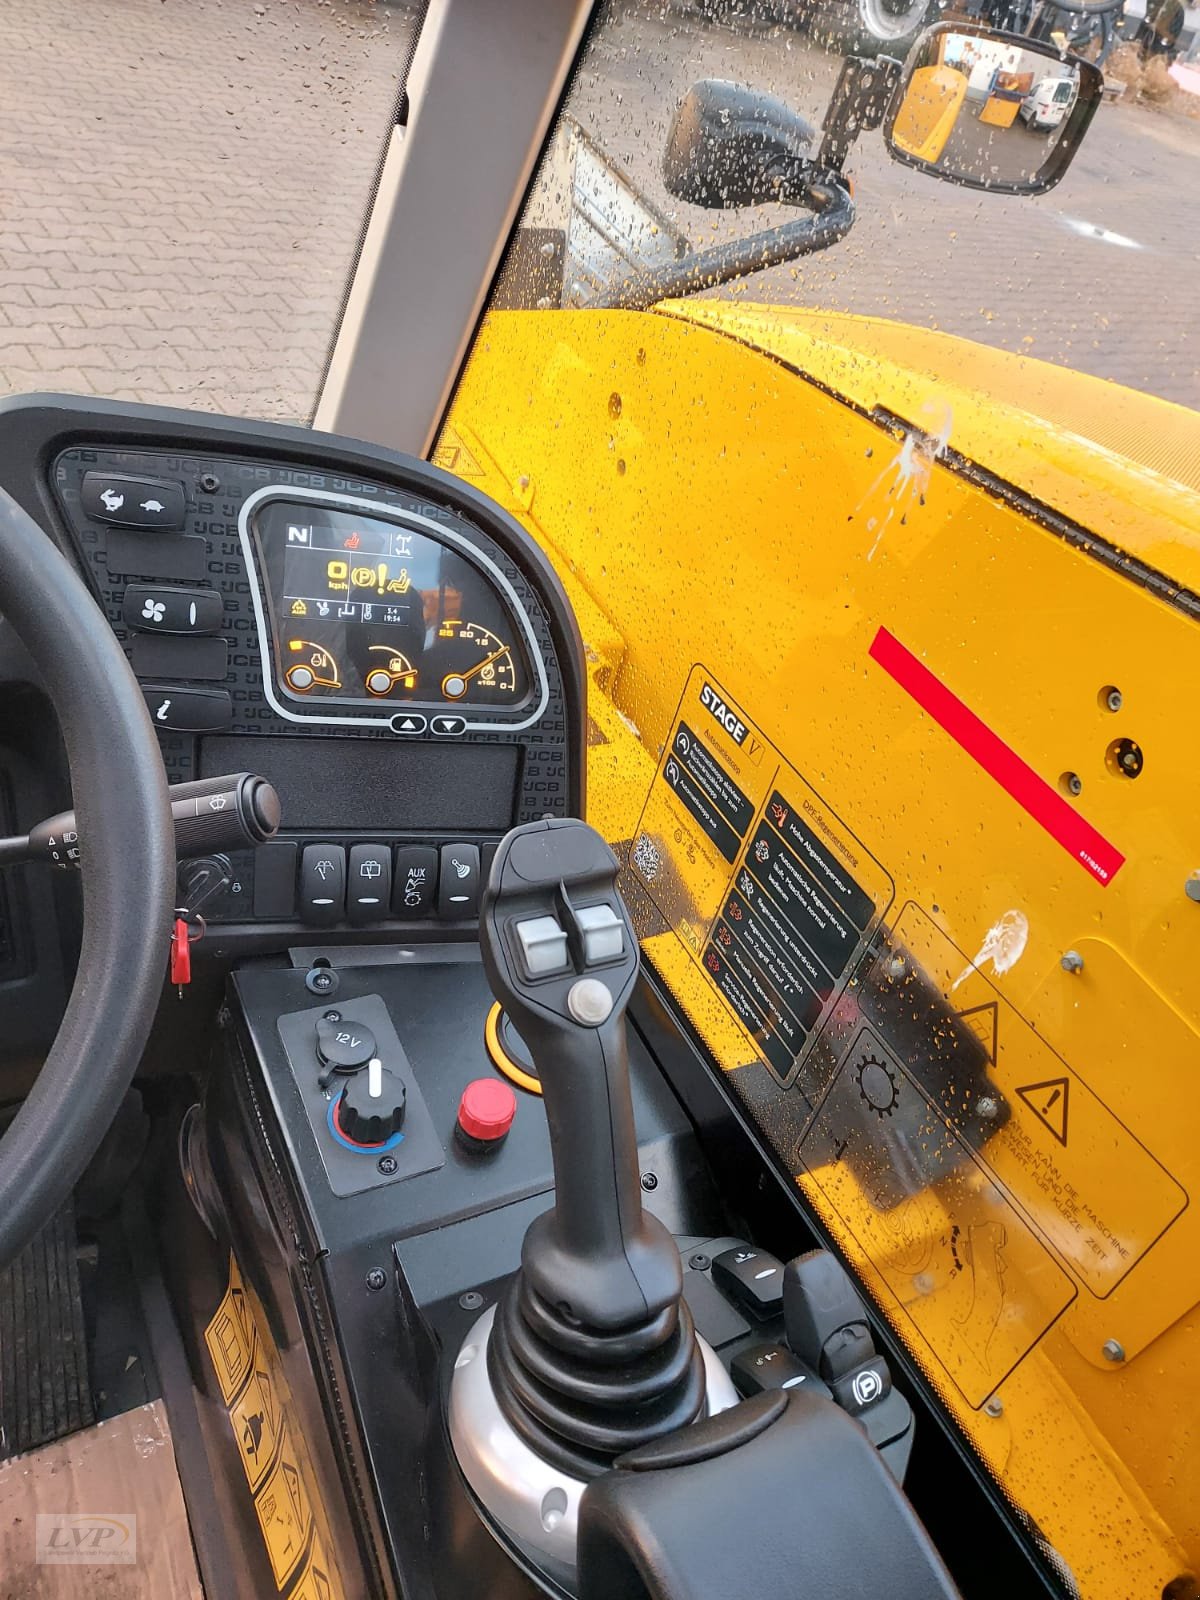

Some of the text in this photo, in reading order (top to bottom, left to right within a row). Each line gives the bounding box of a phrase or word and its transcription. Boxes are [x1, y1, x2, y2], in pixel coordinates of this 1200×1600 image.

[288, 526, 308, 542] N
[327, 561, 348, 579] 0
[328, 581, 349, 591] kph
[383, 614, 401, 622] 19:54
[387, 607, 398, 615] 5.4
[439, 629, 454, 638] 25
[701, 686, 760, 755] STAGE V
[789, 823, 804, 843] Hohe
[408, 868, 426, 877] AUX
[768, 873, 789, 902] bedienen
[778, 852, 847, 939] Automatische Regenerierung
[785, 877, 807, 906] Maschine
[807, 906, 826, 929] normal
[757, 897, 819, 979] Regenerierung unterdrückt
[748, 918, 804, 994] Regeneration erforderlich
[753, 943, 769, 965] Zugriff
[733, 951, 752, 979] Manuelle
[751, 977, 783, 1024] Regenerierung
[1035, 1149, 1062, 1181] KANN
[1064, 1183, 1079, 1201] DIE
[1081, 1204, 1130, 1260] MASCHINE
[1043, 1171, 1063, 1196] UND
[1065, 1198, 1081, 1216] DIE
[1052, 1196, 1083, 1233] KURZE
[1085, 1236, 1108, 1261] ZEIT
